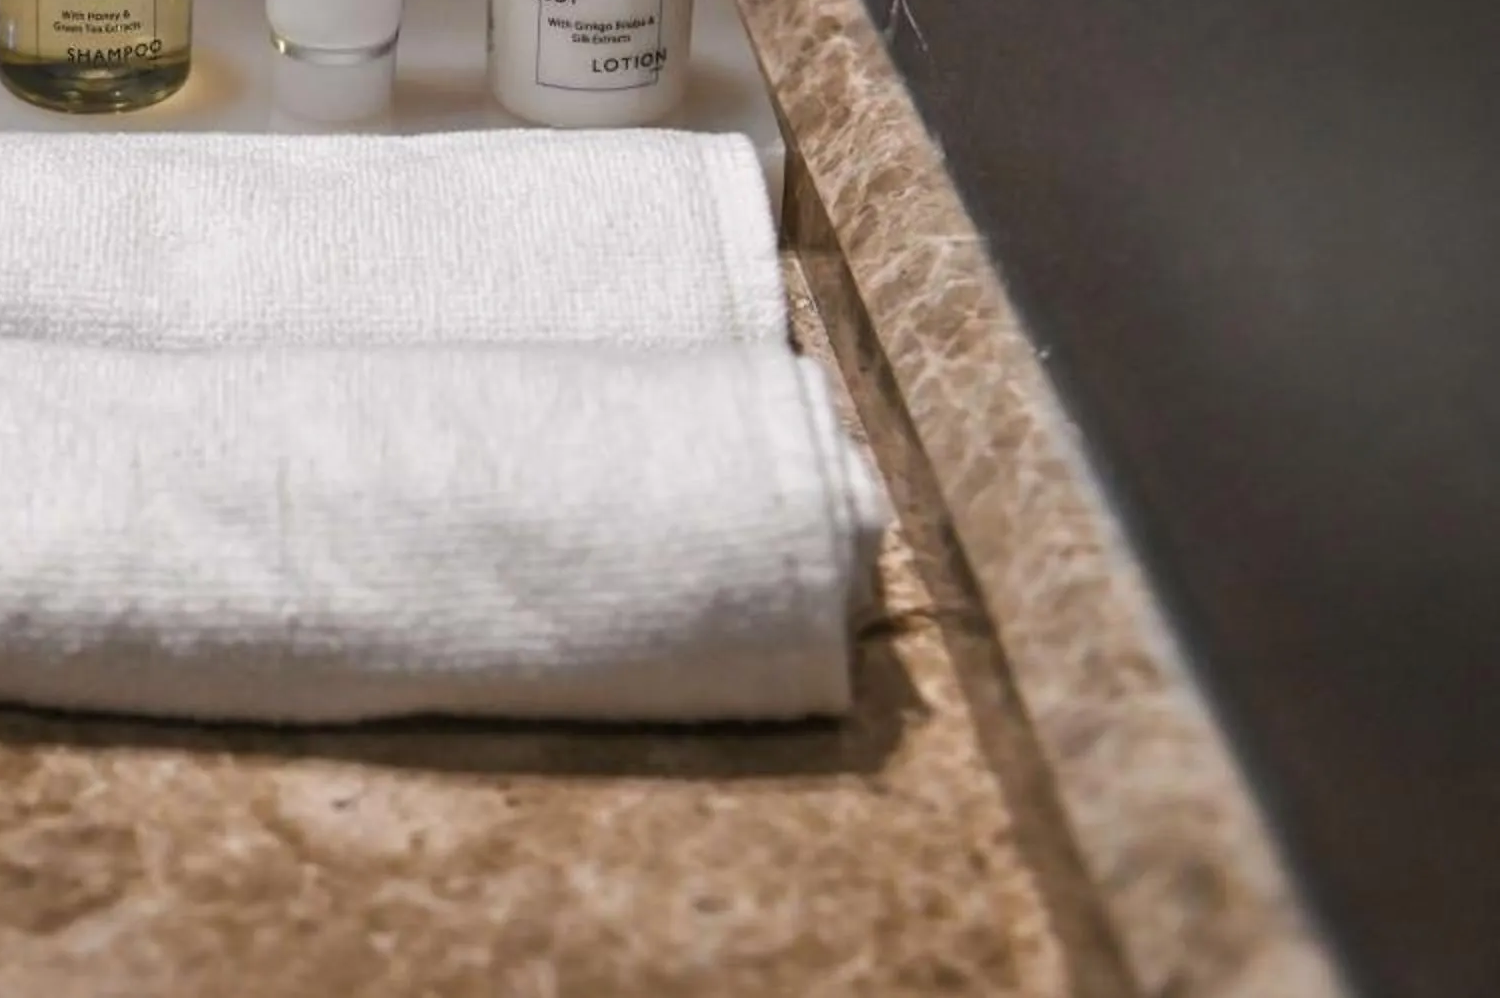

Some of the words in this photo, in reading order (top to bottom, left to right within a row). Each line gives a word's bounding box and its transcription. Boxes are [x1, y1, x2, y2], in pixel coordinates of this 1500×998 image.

[61, 10, 84, 20] With
[88, 11, 120, 21] Honey
[53, 21, 83, 32] Green
[85, 23, 103, 33] Tea
[104, 21, 141, 33] Extracts
[547, 17, 571, 28] With
[575, 20, 612, 32] Ginkgo
[592, 34, 631, 44] Extracts
[67, 38, 162, 64] SHAMPOO
[592, 48, 667, 73] LOTION
